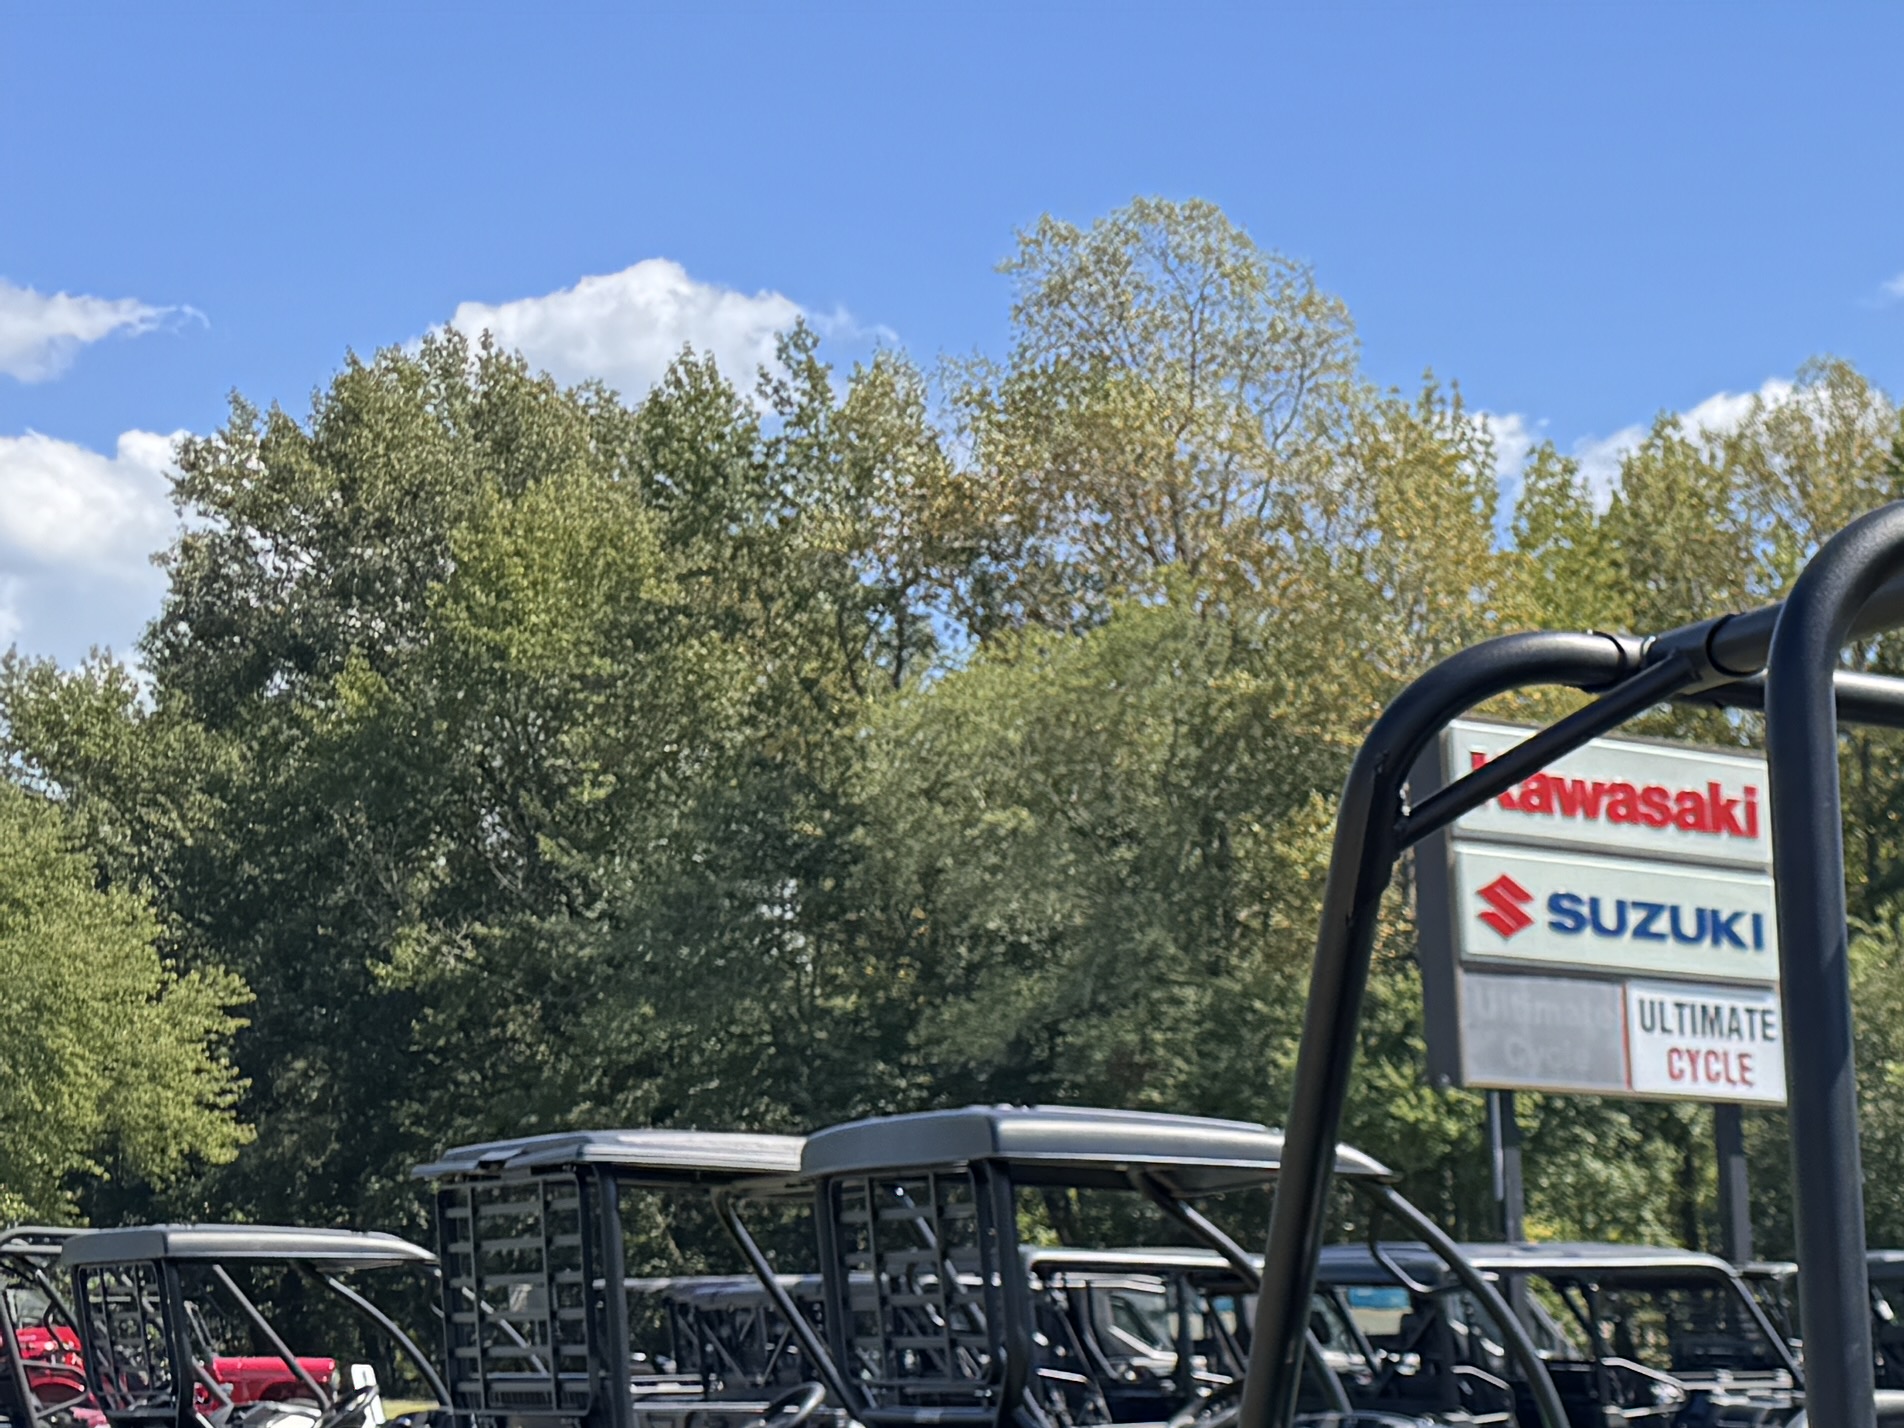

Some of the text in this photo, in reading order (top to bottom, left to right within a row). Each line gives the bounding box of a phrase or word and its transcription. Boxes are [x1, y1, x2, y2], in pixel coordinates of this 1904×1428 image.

[1546, 891, 1766, 951] SUZUKI
[1638, 998, 1778, 1043] ULTIMATE
[1667, 1047, 1755, 1087] CYCLE
